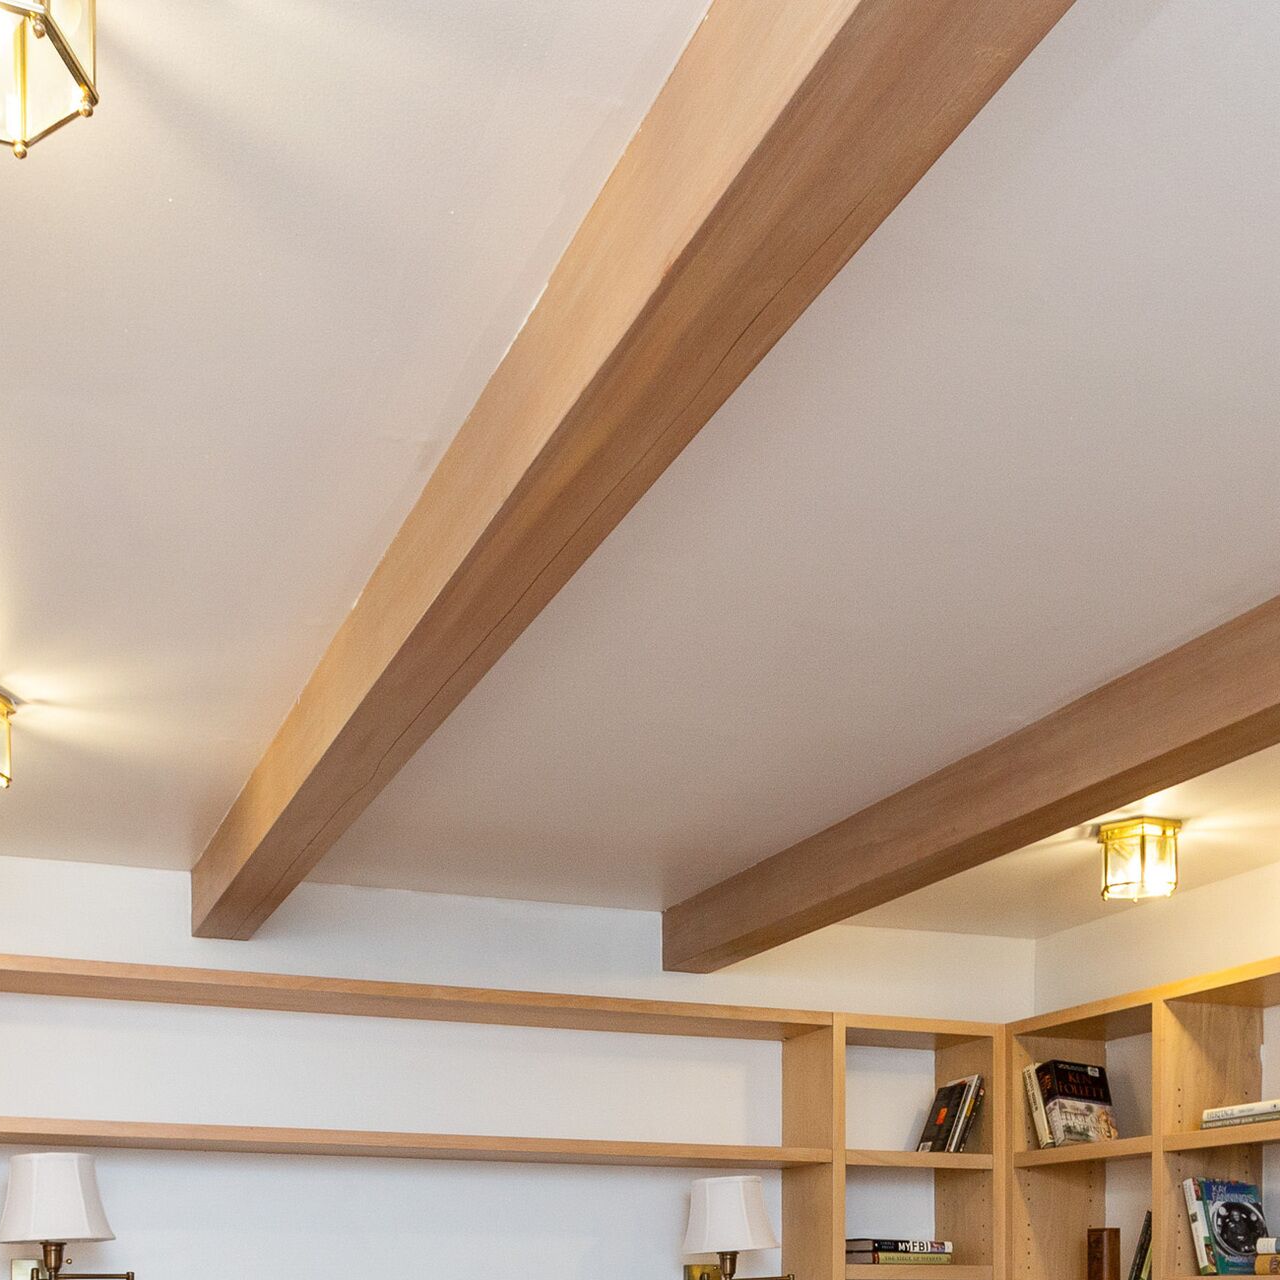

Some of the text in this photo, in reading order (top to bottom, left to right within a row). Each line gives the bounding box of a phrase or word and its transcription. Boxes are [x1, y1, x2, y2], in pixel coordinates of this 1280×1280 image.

[1068, 1072, 1091, 1083] KEN
[898, 1242, 929, 1251] MY FBI
